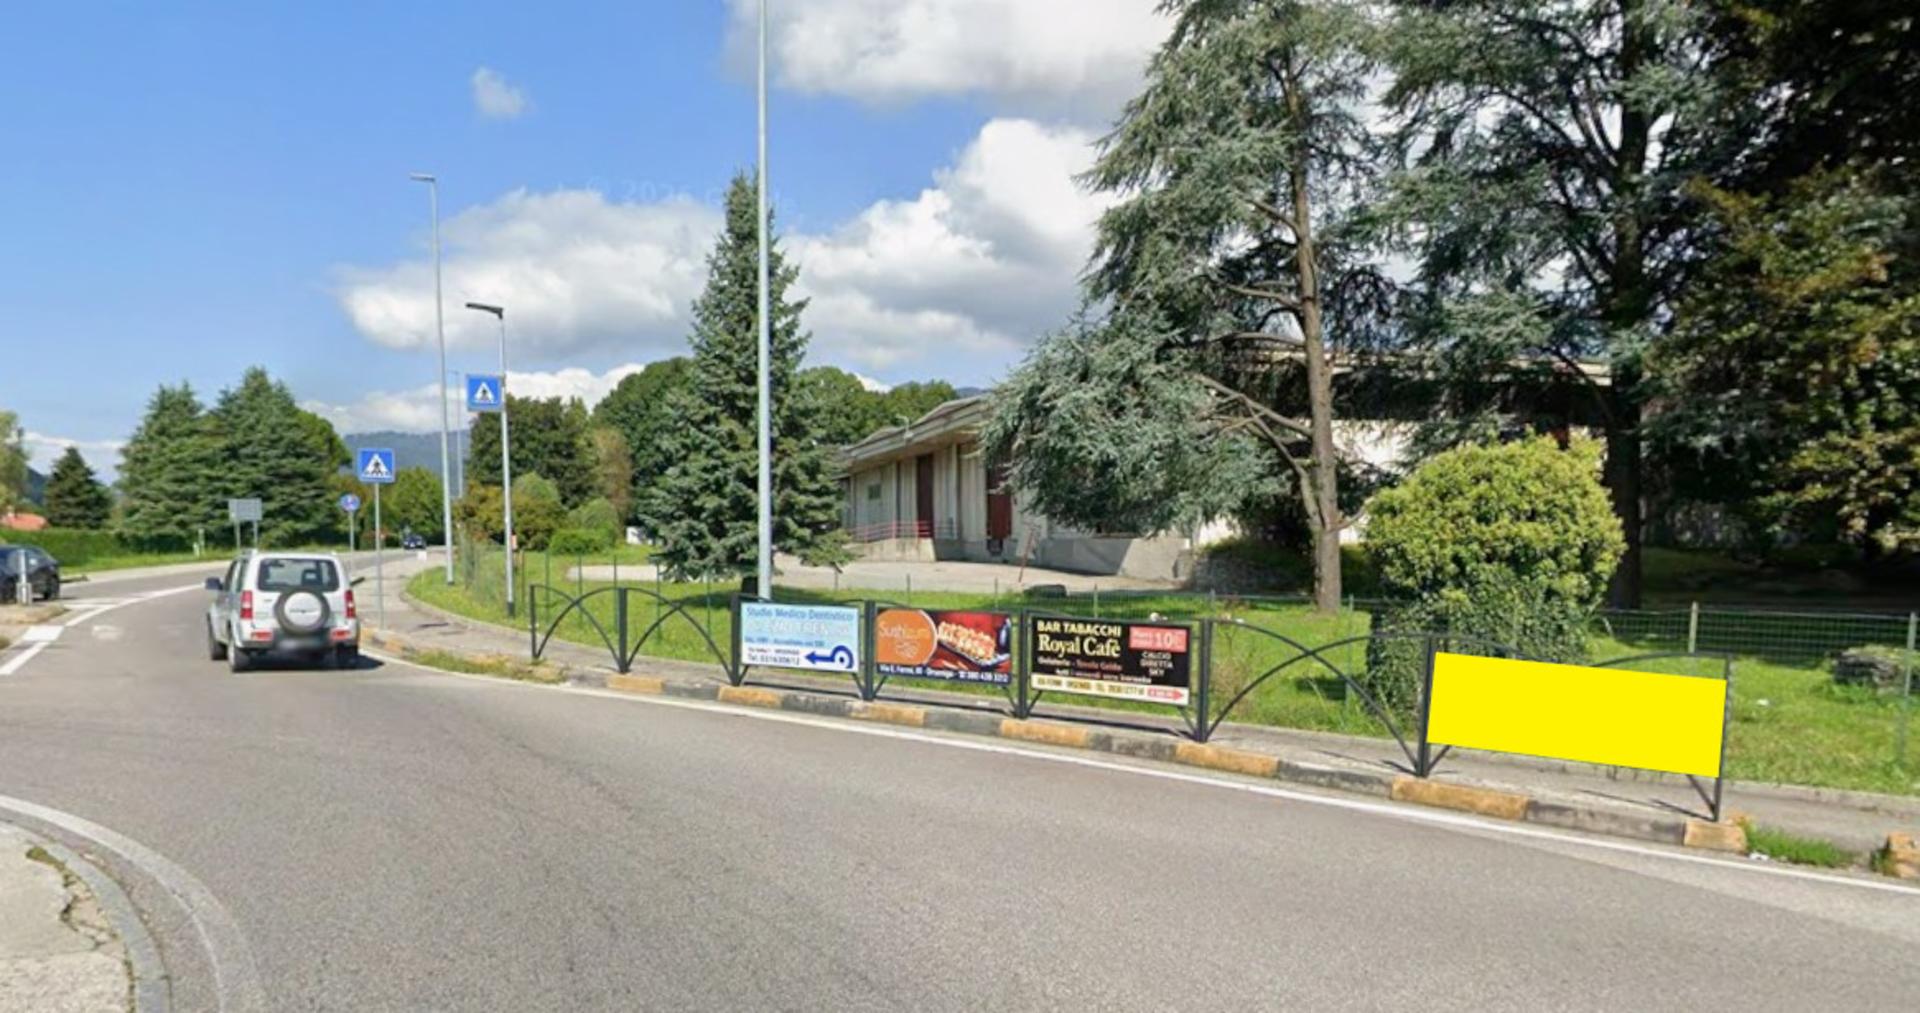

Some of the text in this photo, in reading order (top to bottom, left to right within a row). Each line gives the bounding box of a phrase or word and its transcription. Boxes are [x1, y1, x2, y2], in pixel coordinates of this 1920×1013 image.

[746, 606, 773, 617] Studio
[775, 607, 807, 619] Medico
[1037, 620, 1121, 637] BAR TABACCHI
[1038, 633, 1081, 658] Royal
